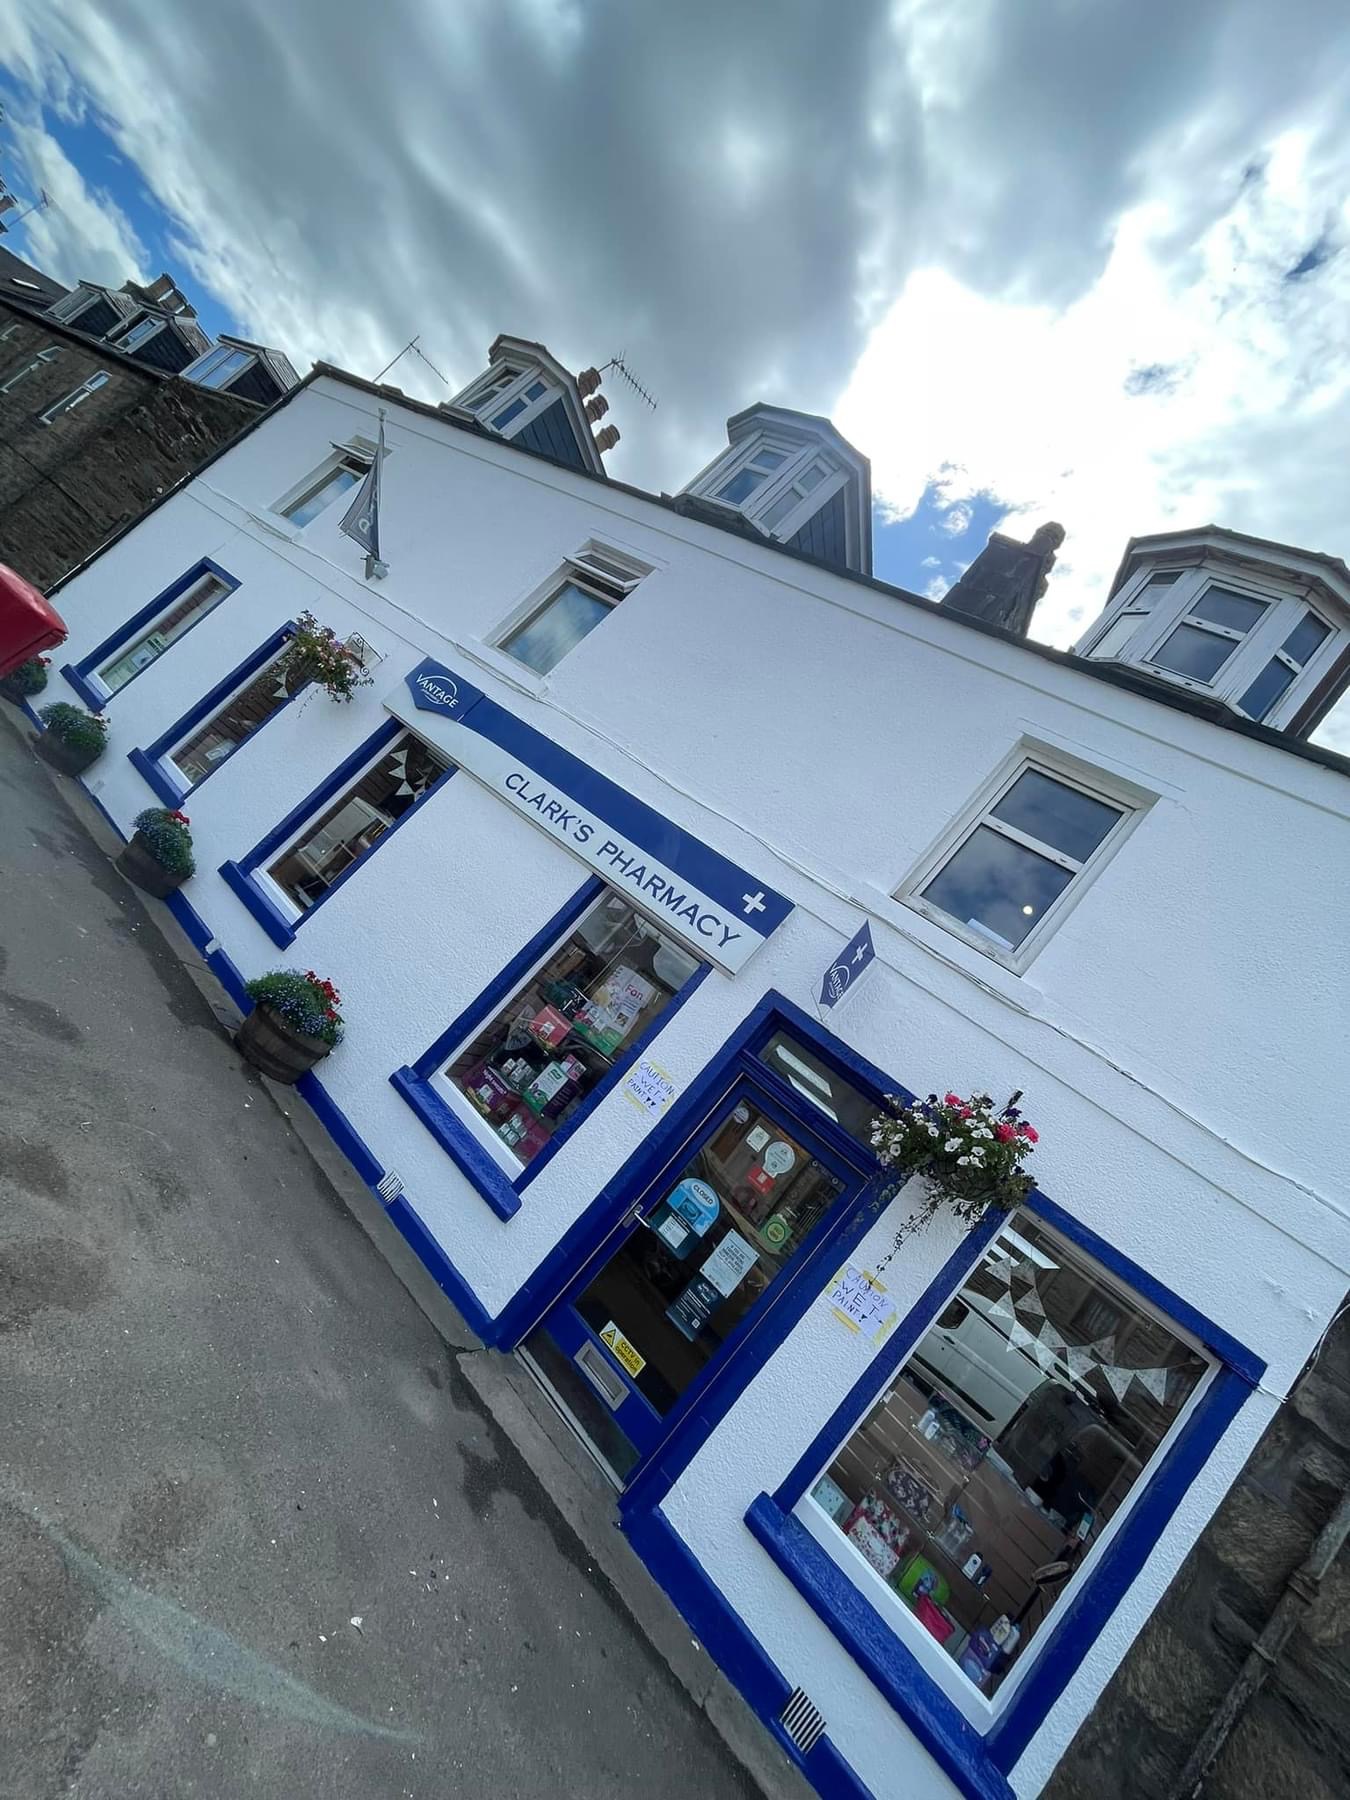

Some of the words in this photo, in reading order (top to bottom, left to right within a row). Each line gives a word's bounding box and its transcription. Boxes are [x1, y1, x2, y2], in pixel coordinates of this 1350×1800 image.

[415, 673, 459, 708] VANTAGE
[504, 772, 595, 843] CLARK'S
[596, 840, 742, 948] PHARMACY
[625, 983, 644, 1001] Fan
[640, 1061, 675, 1095] CAUTION
[641, 1074, 662, 1097] WET
[693, 1184, 714, 1205] CLOSED
[841, 1280, 880, 1316] WET
[620, 1342, 635, 1359] CCTV
